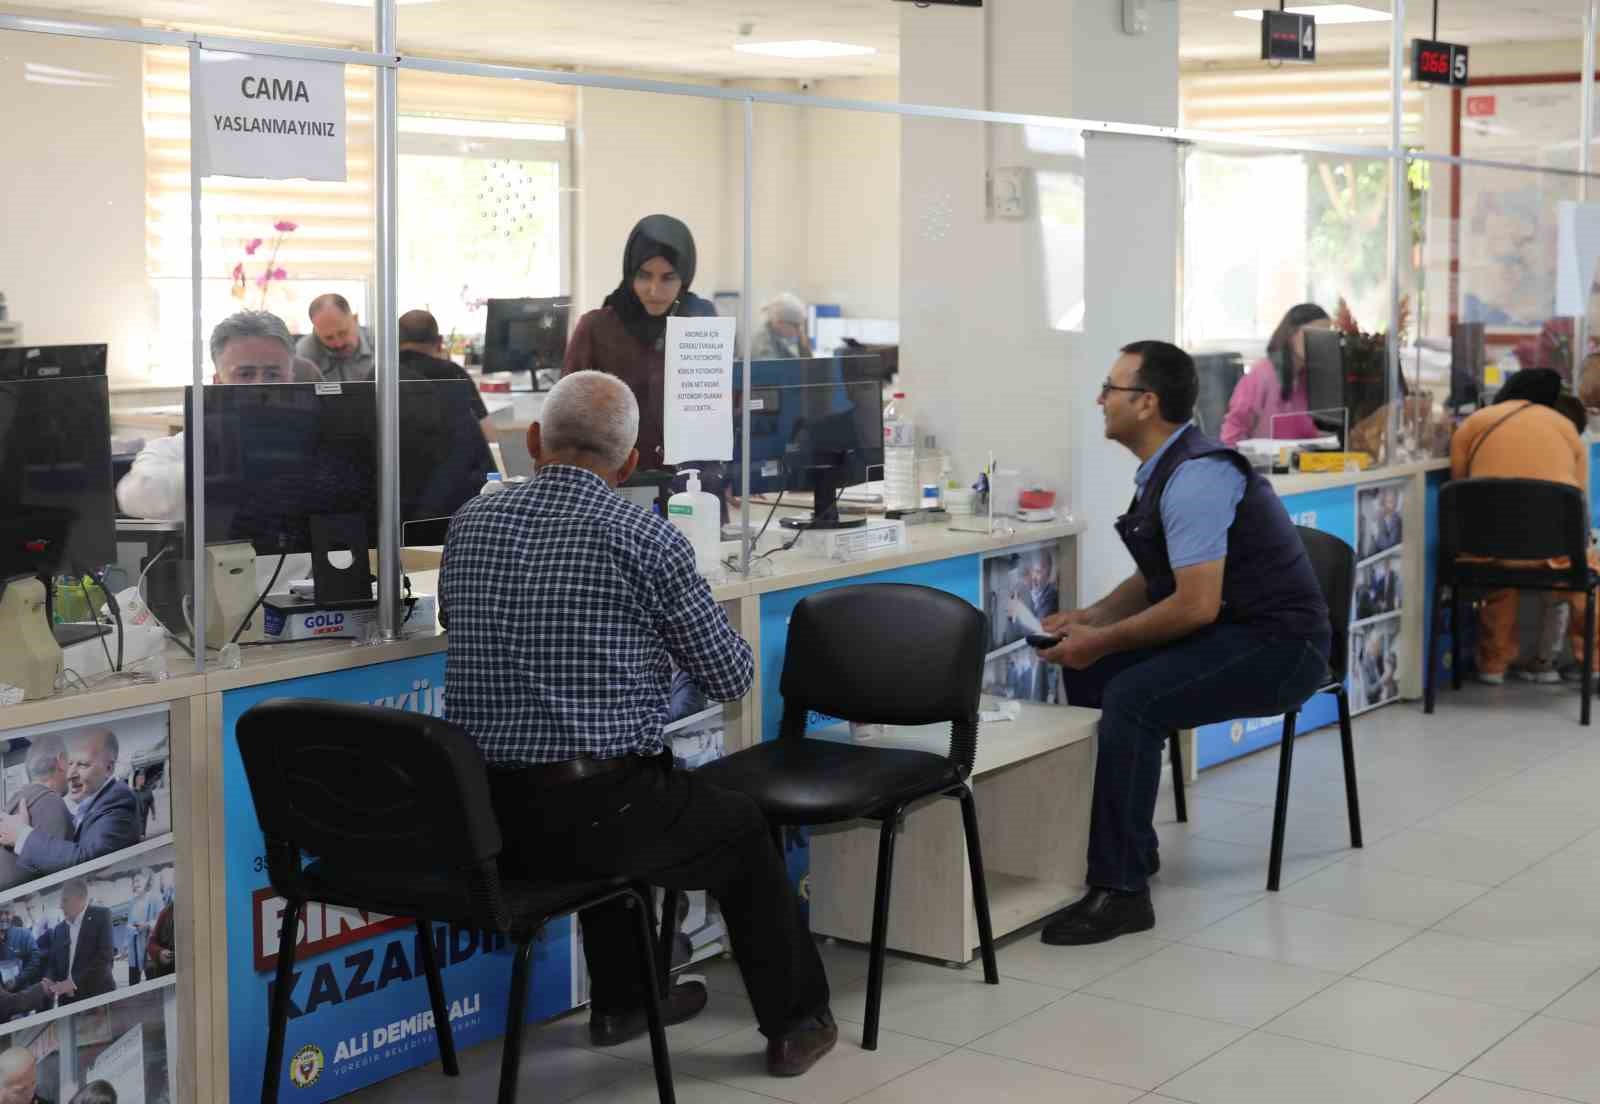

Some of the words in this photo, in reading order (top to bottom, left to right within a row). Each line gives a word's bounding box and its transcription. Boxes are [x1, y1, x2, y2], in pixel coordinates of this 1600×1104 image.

[1303, 25, 1313, 51] 4
[1454, 53, 1467, 79] 5
[241, 75, 310, 103] CAMA
[213, 114, 336, 137] YASLANMAYINIZ
[304, 612, 345, 629] GOLD
